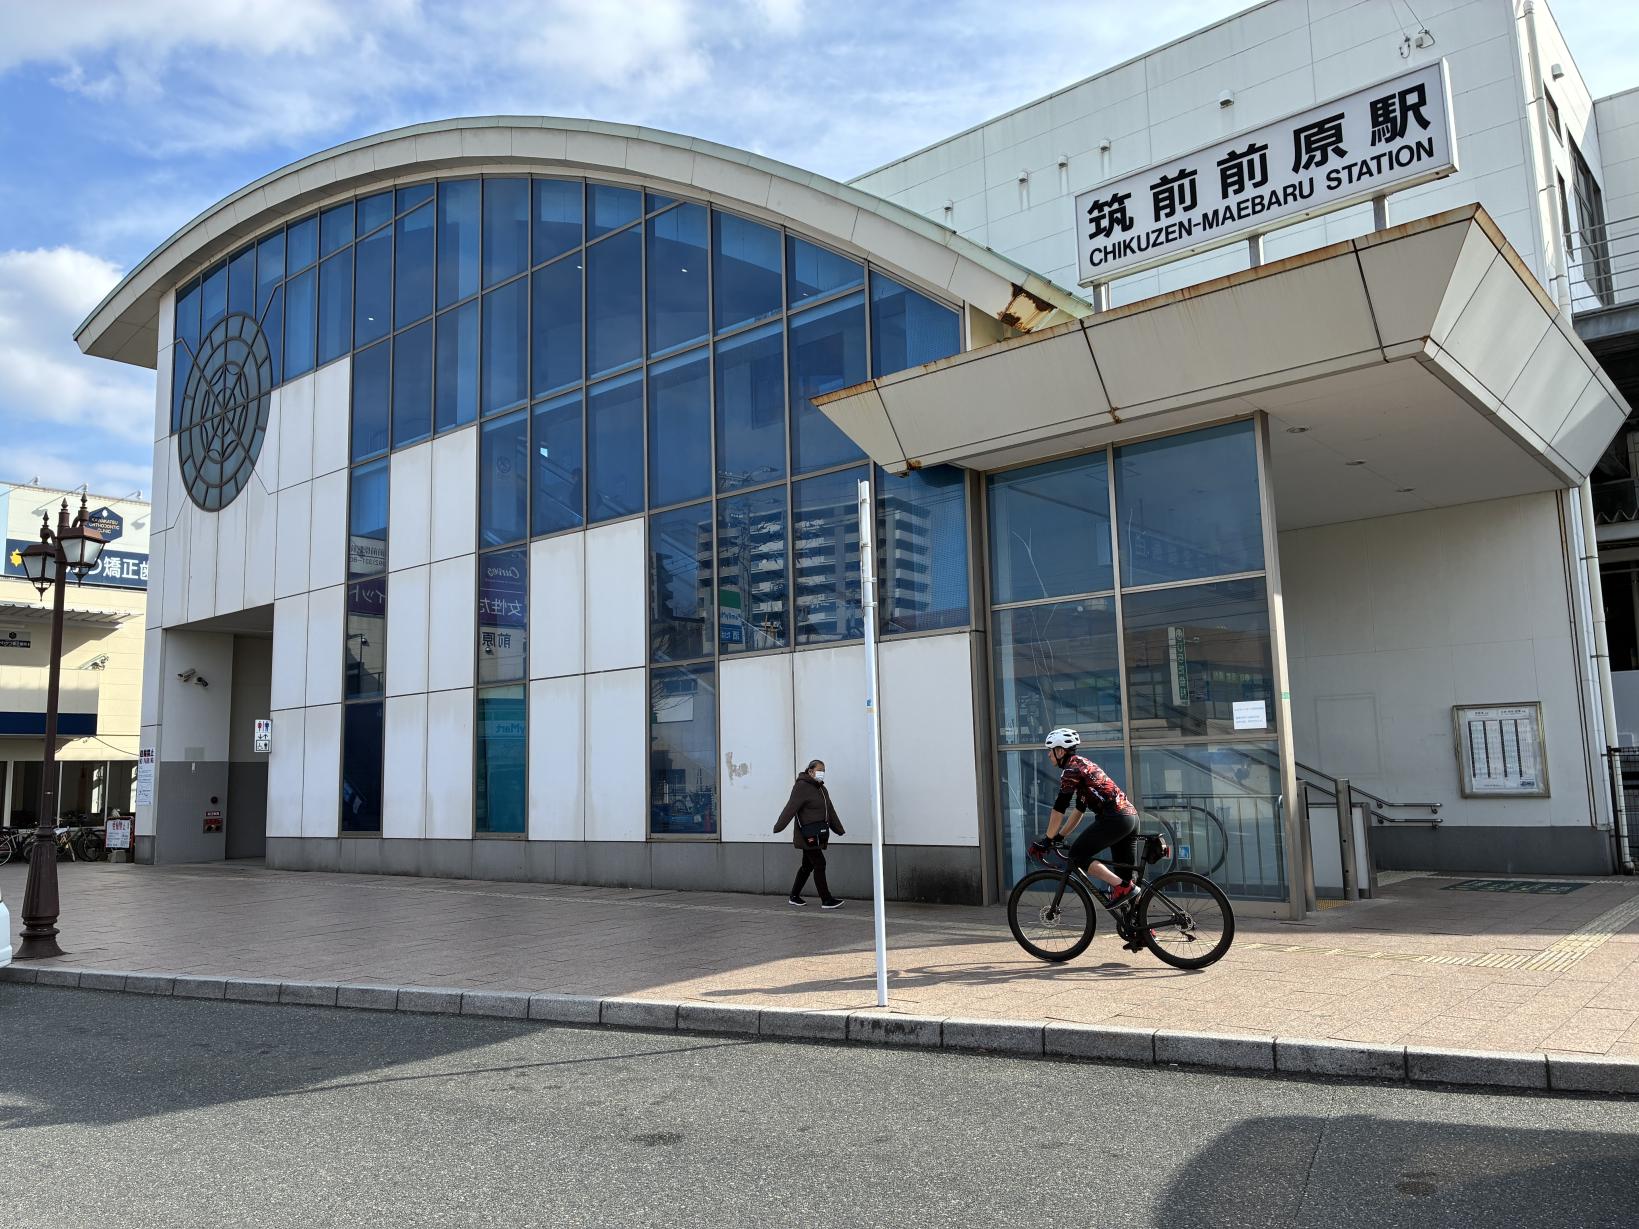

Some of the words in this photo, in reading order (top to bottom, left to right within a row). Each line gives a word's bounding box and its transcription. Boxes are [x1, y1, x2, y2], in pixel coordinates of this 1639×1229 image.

[1087, 82, 1431, 241] 筑前前原駅
[1089, 177, 1314, 267] CHIKUZEN-MAEBARU
[1325, 137, 1434, 191] STATION
